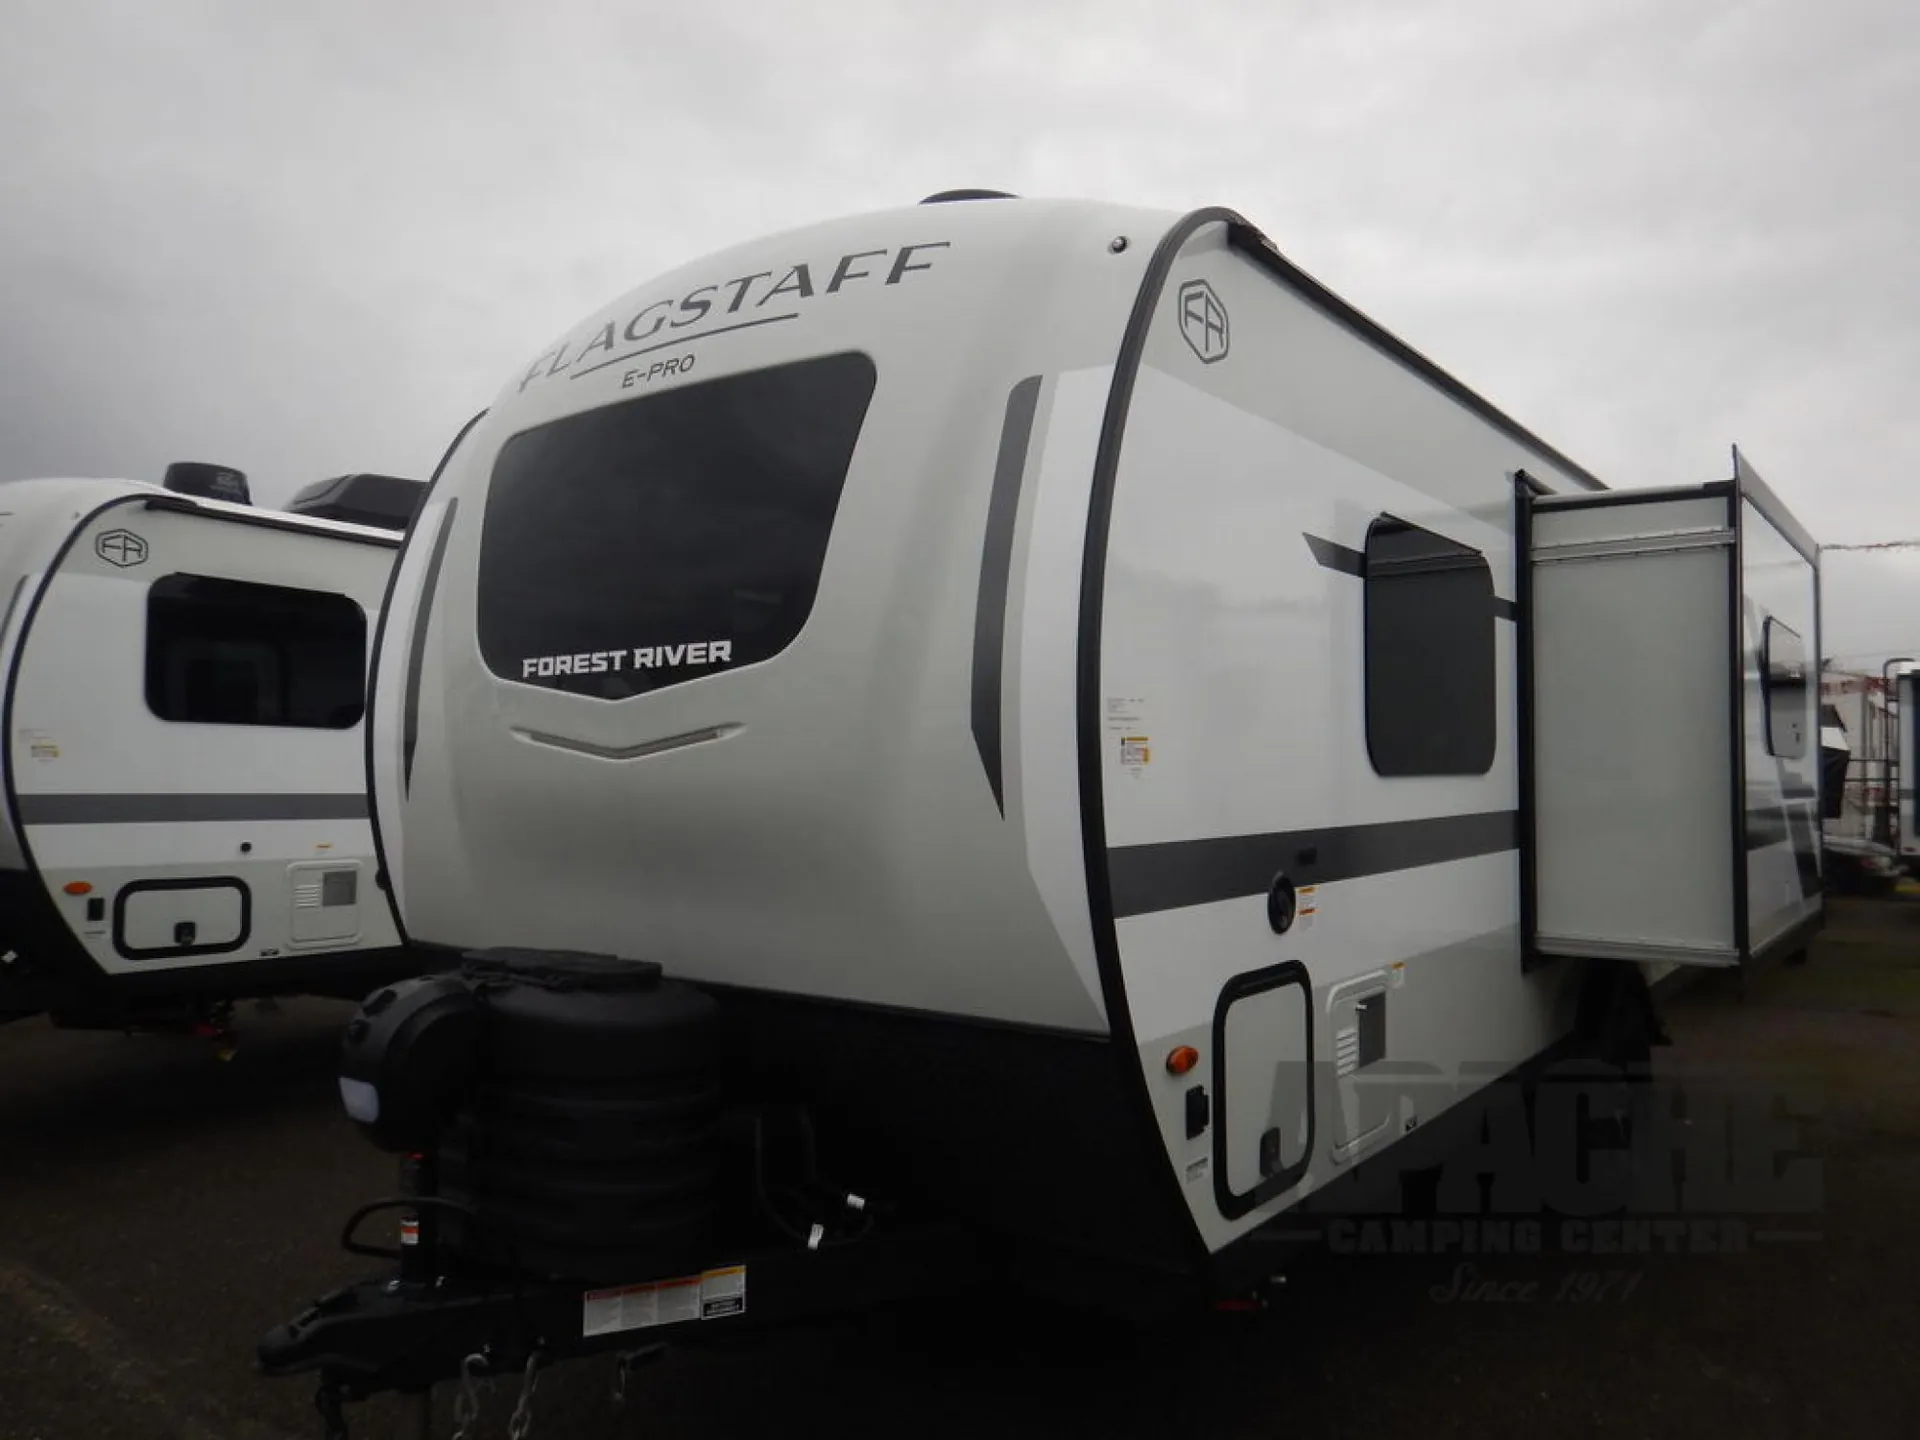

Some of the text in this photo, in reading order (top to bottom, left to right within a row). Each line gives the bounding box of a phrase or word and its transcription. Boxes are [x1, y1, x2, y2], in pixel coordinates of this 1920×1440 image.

[519, 241, 951, 393] FLAGSTAFF
[621, 353, 696, 389] E-PRO
[522, 640, 732, 678] FOREST RIVER
